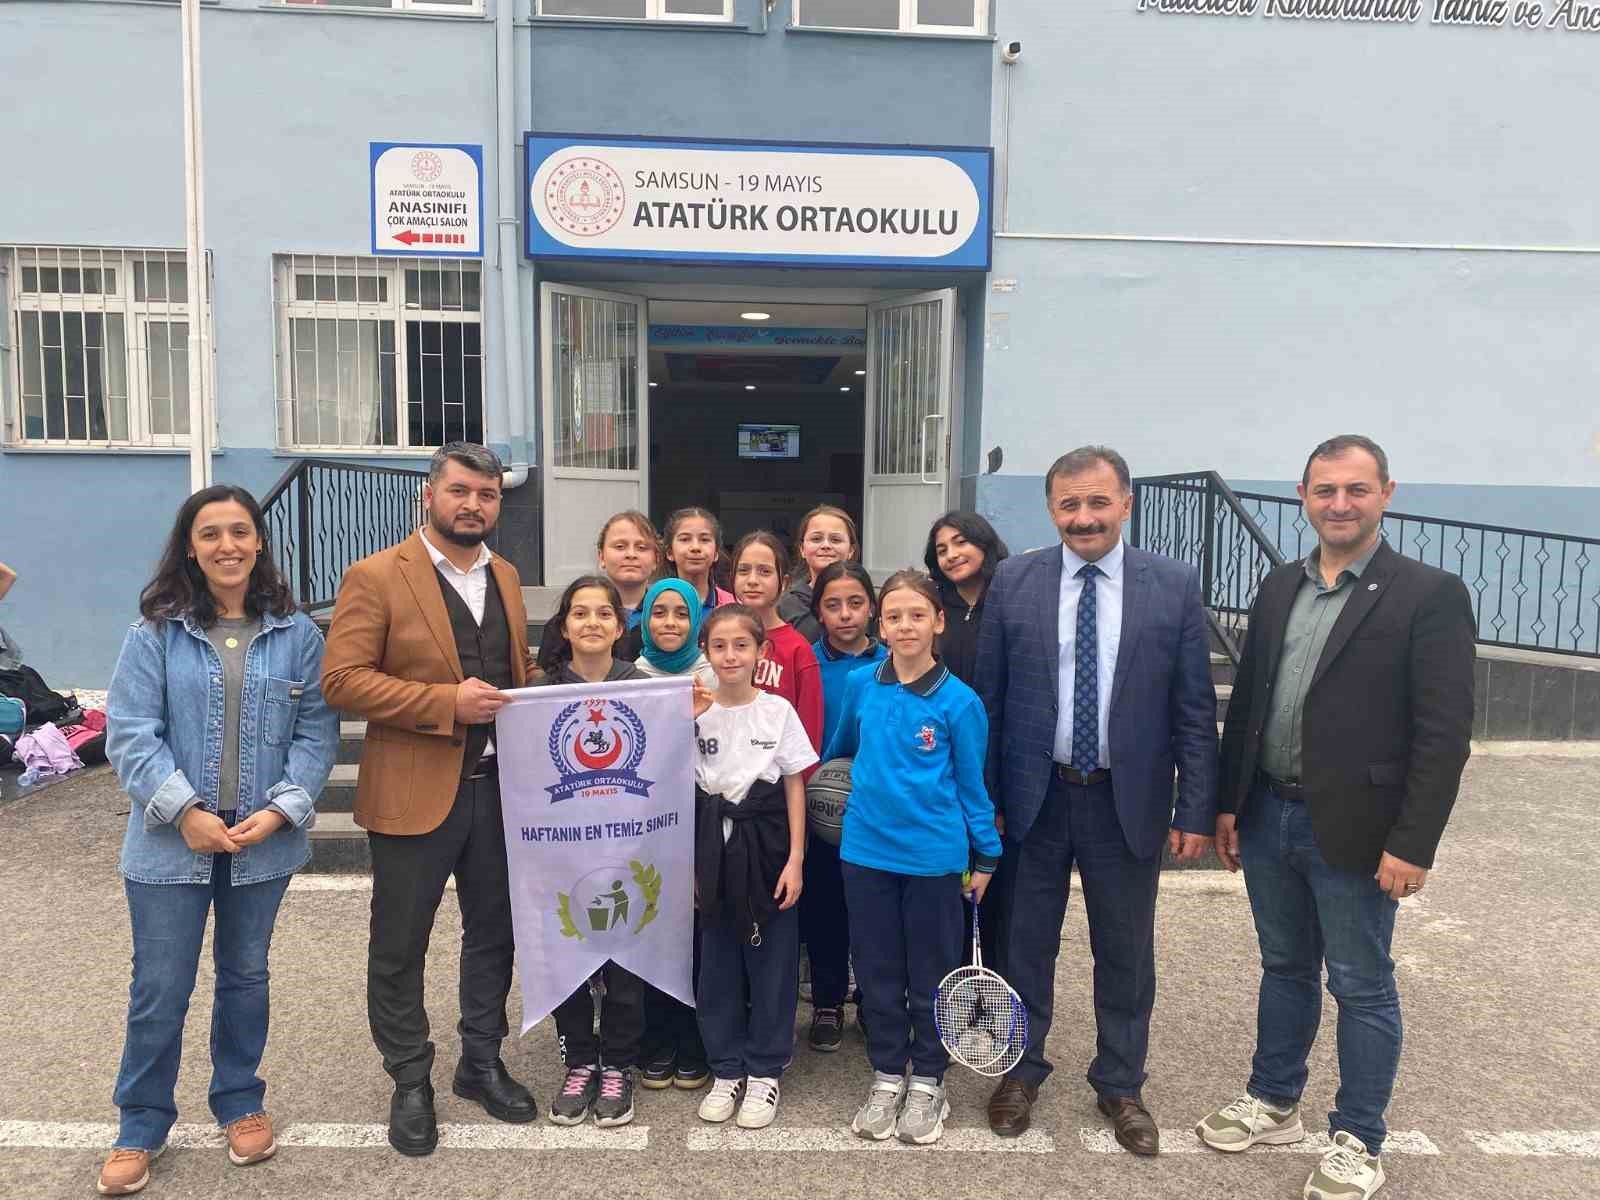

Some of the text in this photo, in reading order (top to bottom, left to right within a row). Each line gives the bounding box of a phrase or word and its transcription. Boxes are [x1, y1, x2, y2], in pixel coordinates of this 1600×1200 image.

[1512, 3, 1544, 27] ve
[634, 170, 719, 191] SAMSUN
[738, 174, 760, 192] 19
[765, 175, 823, 193] MAYIS
[389, 189, 466, 198] ATATÜRK ORTAOKULU
[389, 201, 467, 214] ANASINIFI
[387, 215, 468, 228] ÇOK AMAÇLI SALON
[633, 198, 958, 236] ATATÜRK ORTAOKULU
[554, 777, 644, 794] ATATÜRK ORTAOKULU
[592, 788, 618, 796] MAYIS
[521, 811, 679, 842] HAFTANIN EN TEMİZ SINIFI
